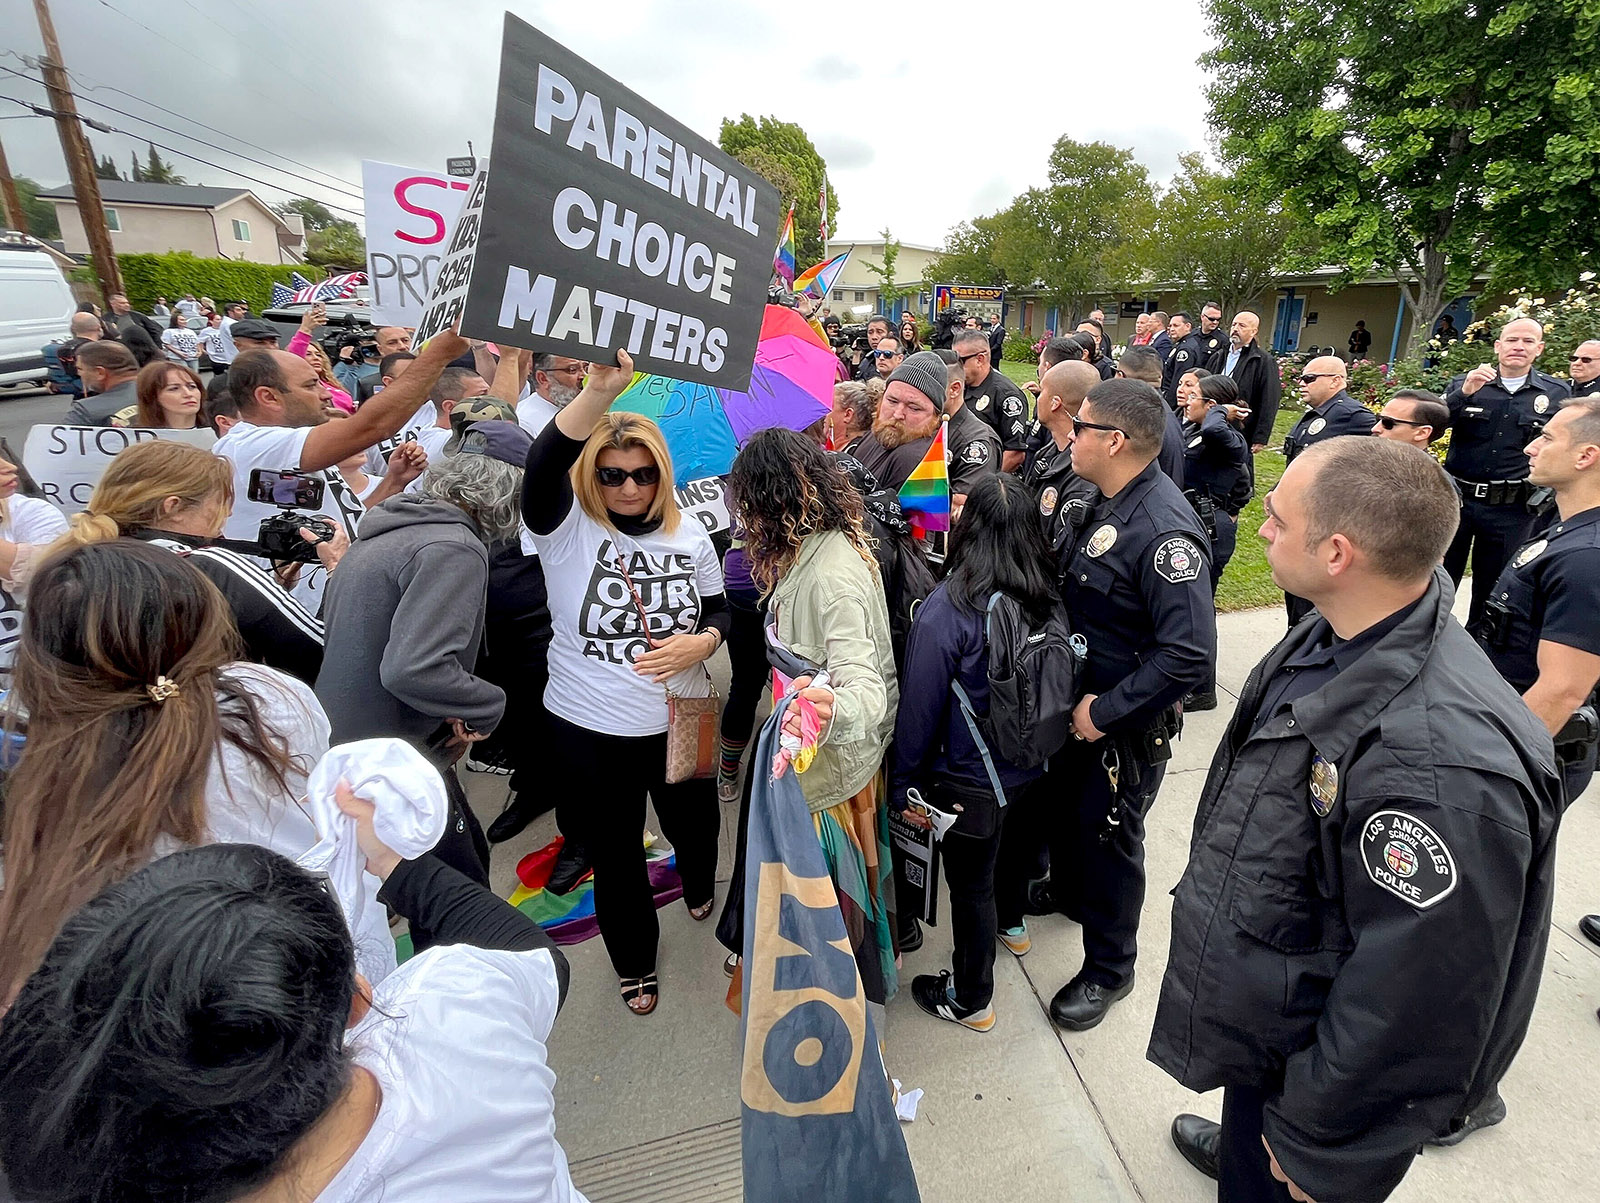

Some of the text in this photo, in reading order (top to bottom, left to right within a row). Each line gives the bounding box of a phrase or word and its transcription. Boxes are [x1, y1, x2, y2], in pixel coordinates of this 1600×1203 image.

[534, 63, 760, 237] PARENTAL
[552, 187, 736, 305] CHOICE
[950, 286, 1002, 297] Saticoy
[497, 265, 728, 373] MATTERS
[1157, 540, 1198, 565] LOS ANGELES
[1169, 569, 1195, 579] POLICE
[597, 577, 695, 613] OUR
[586, 603, 697, 635] KIDS
[1366, 817, 1449, 875] LOS ANGELES
[1388, 830, 1419, 850] SCHOOL
[1375, 866, 1422, 900] POLICE
